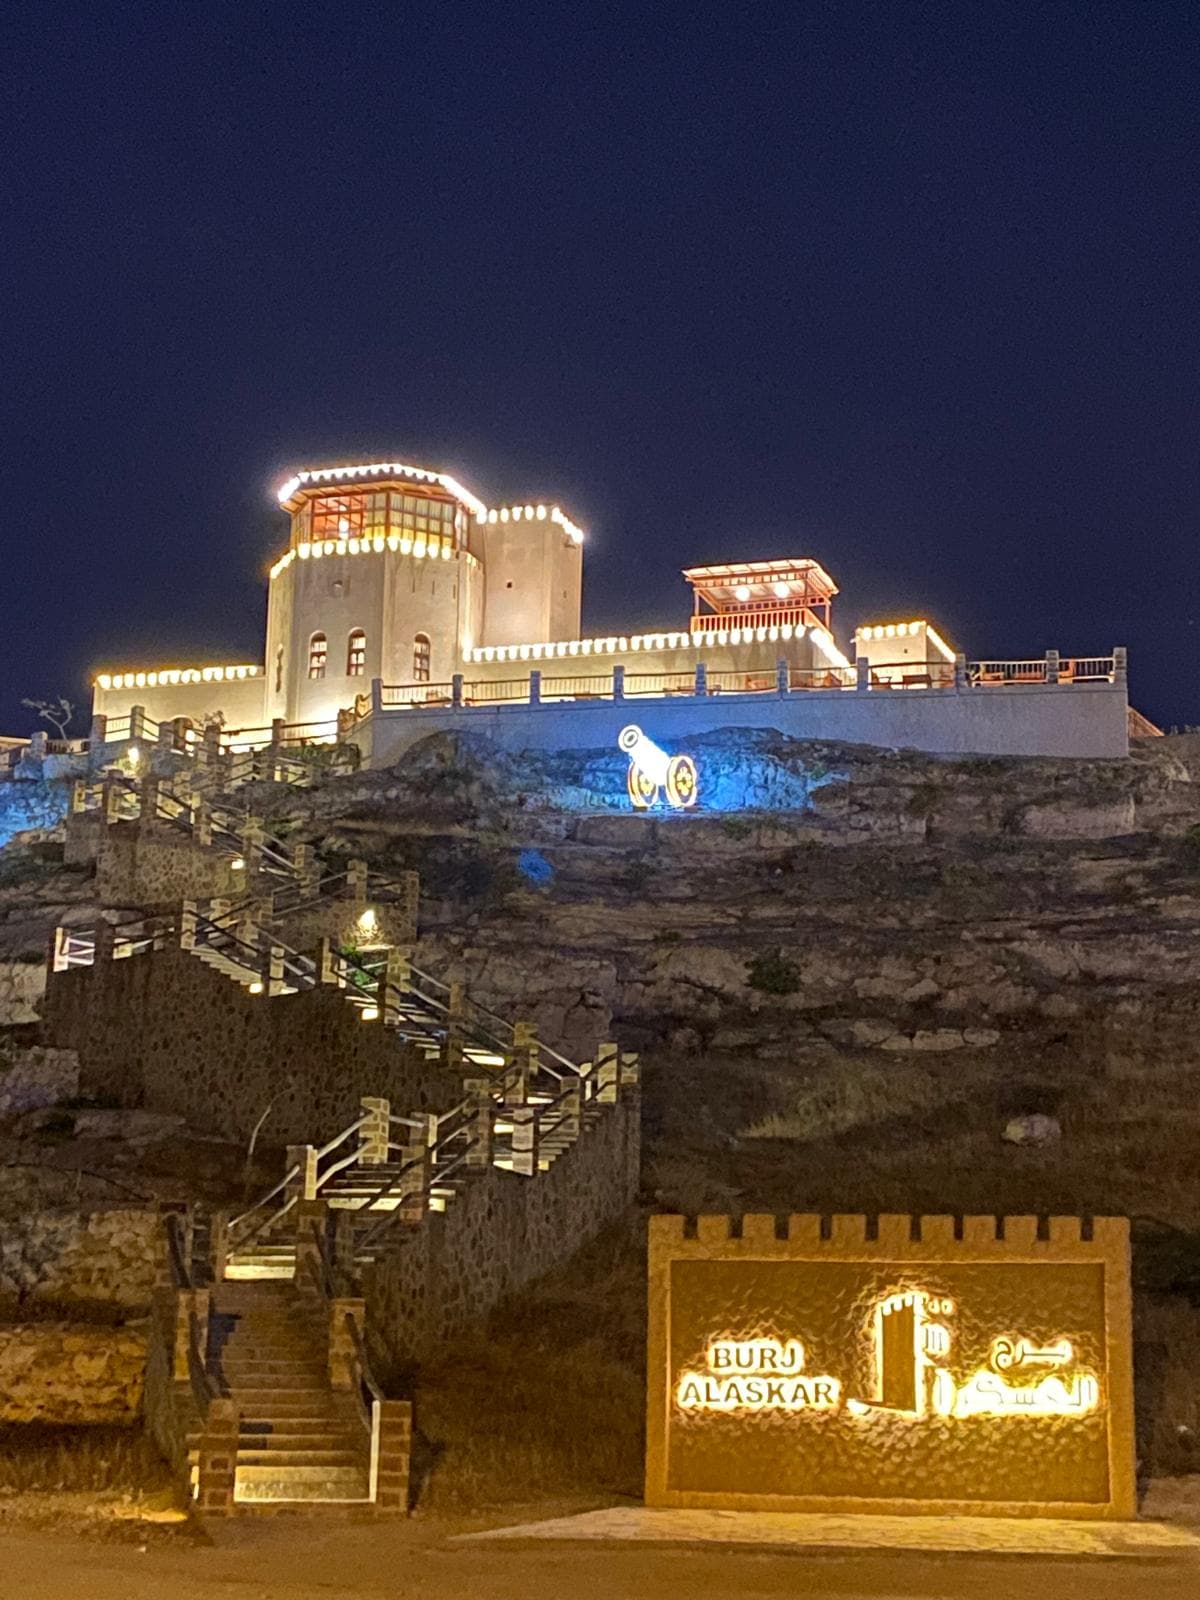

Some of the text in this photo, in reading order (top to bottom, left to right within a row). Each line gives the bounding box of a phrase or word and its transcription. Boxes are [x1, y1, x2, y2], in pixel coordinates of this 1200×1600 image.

[711, 1346, 797, 1370] BURJ
[994, 1340, 1067, 1374] برج
[681, 1380, 836, 1404] ALASKAR
